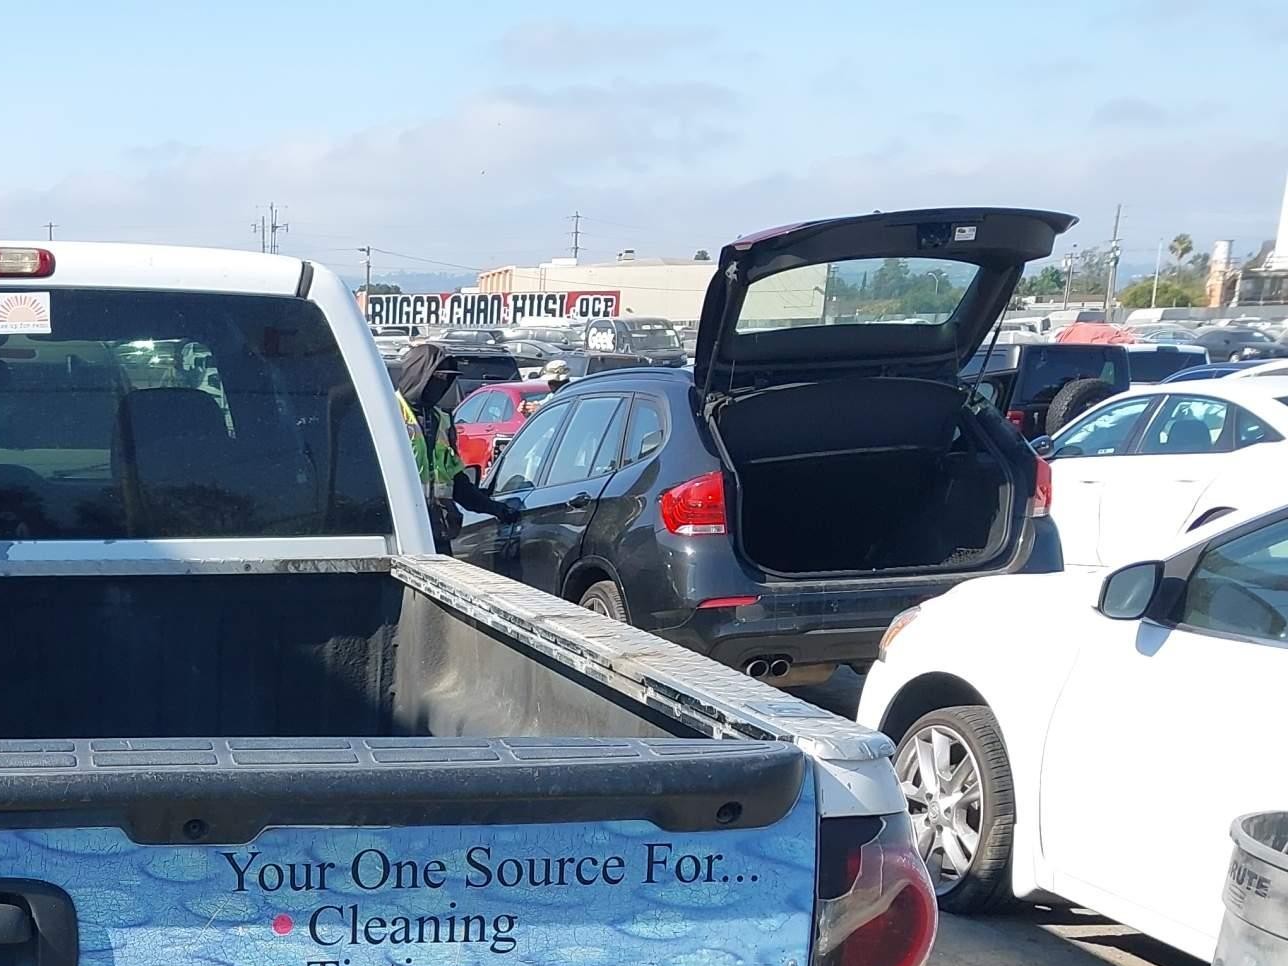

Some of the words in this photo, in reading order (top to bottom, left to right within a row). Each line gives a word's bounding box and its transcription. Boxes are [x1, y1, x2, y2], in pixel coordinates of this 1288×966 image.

[588, 327, 615, 350] Geek
[221, 847, 337, 894] Your
[350, 848, 447, 890] One
[465, 847, 626, 889] Source
[642, 842, 759, 884] For...
[1227, 860, 1272, 898] RUTE
[308, 902, 519, 953] Cleaning
